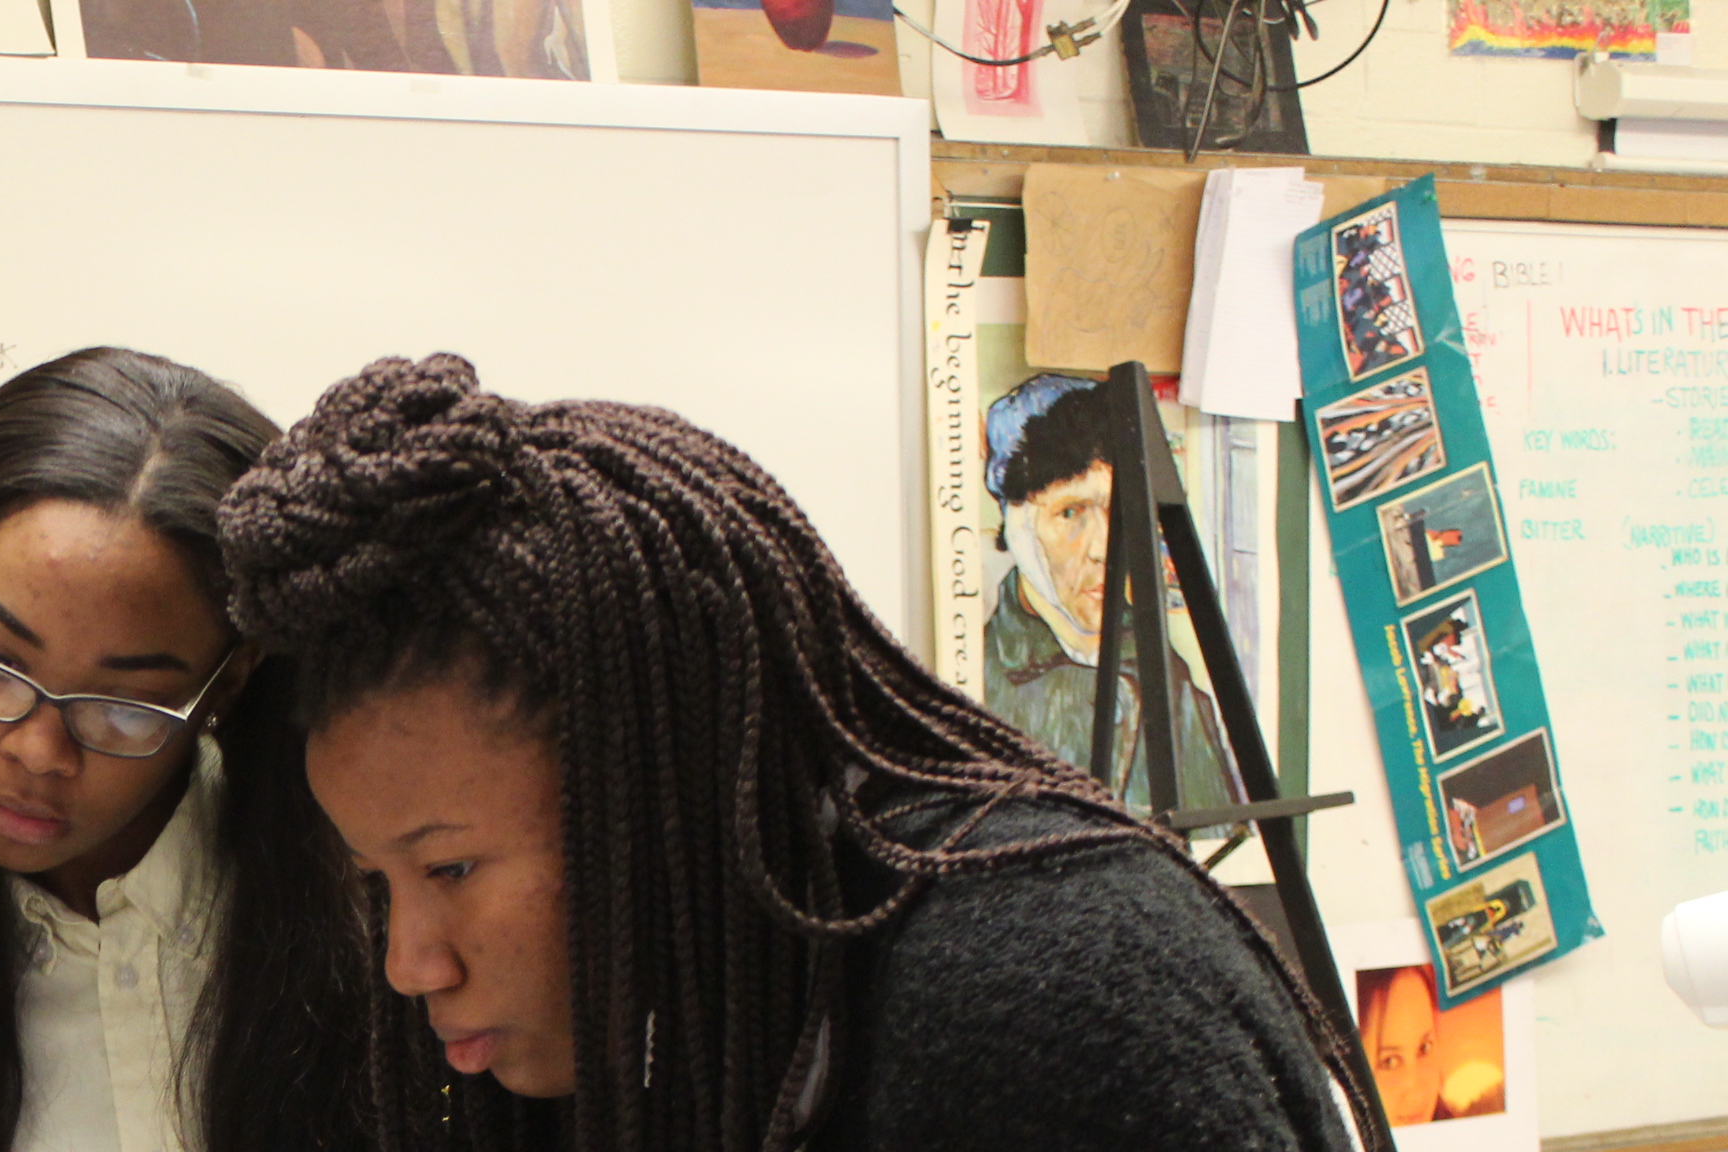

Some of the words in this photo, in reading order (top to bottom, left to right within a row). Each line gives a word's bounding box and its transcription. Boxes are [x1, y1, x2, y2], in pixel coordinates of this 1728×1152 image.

[1653, 305, 1674, 336] IN
[1681, 306, 1728, 342] THE
[931, 332, 973, 514] beginning
[1521, 518, 1586, 541] BITTER
[951, 525, 980, 600] God
